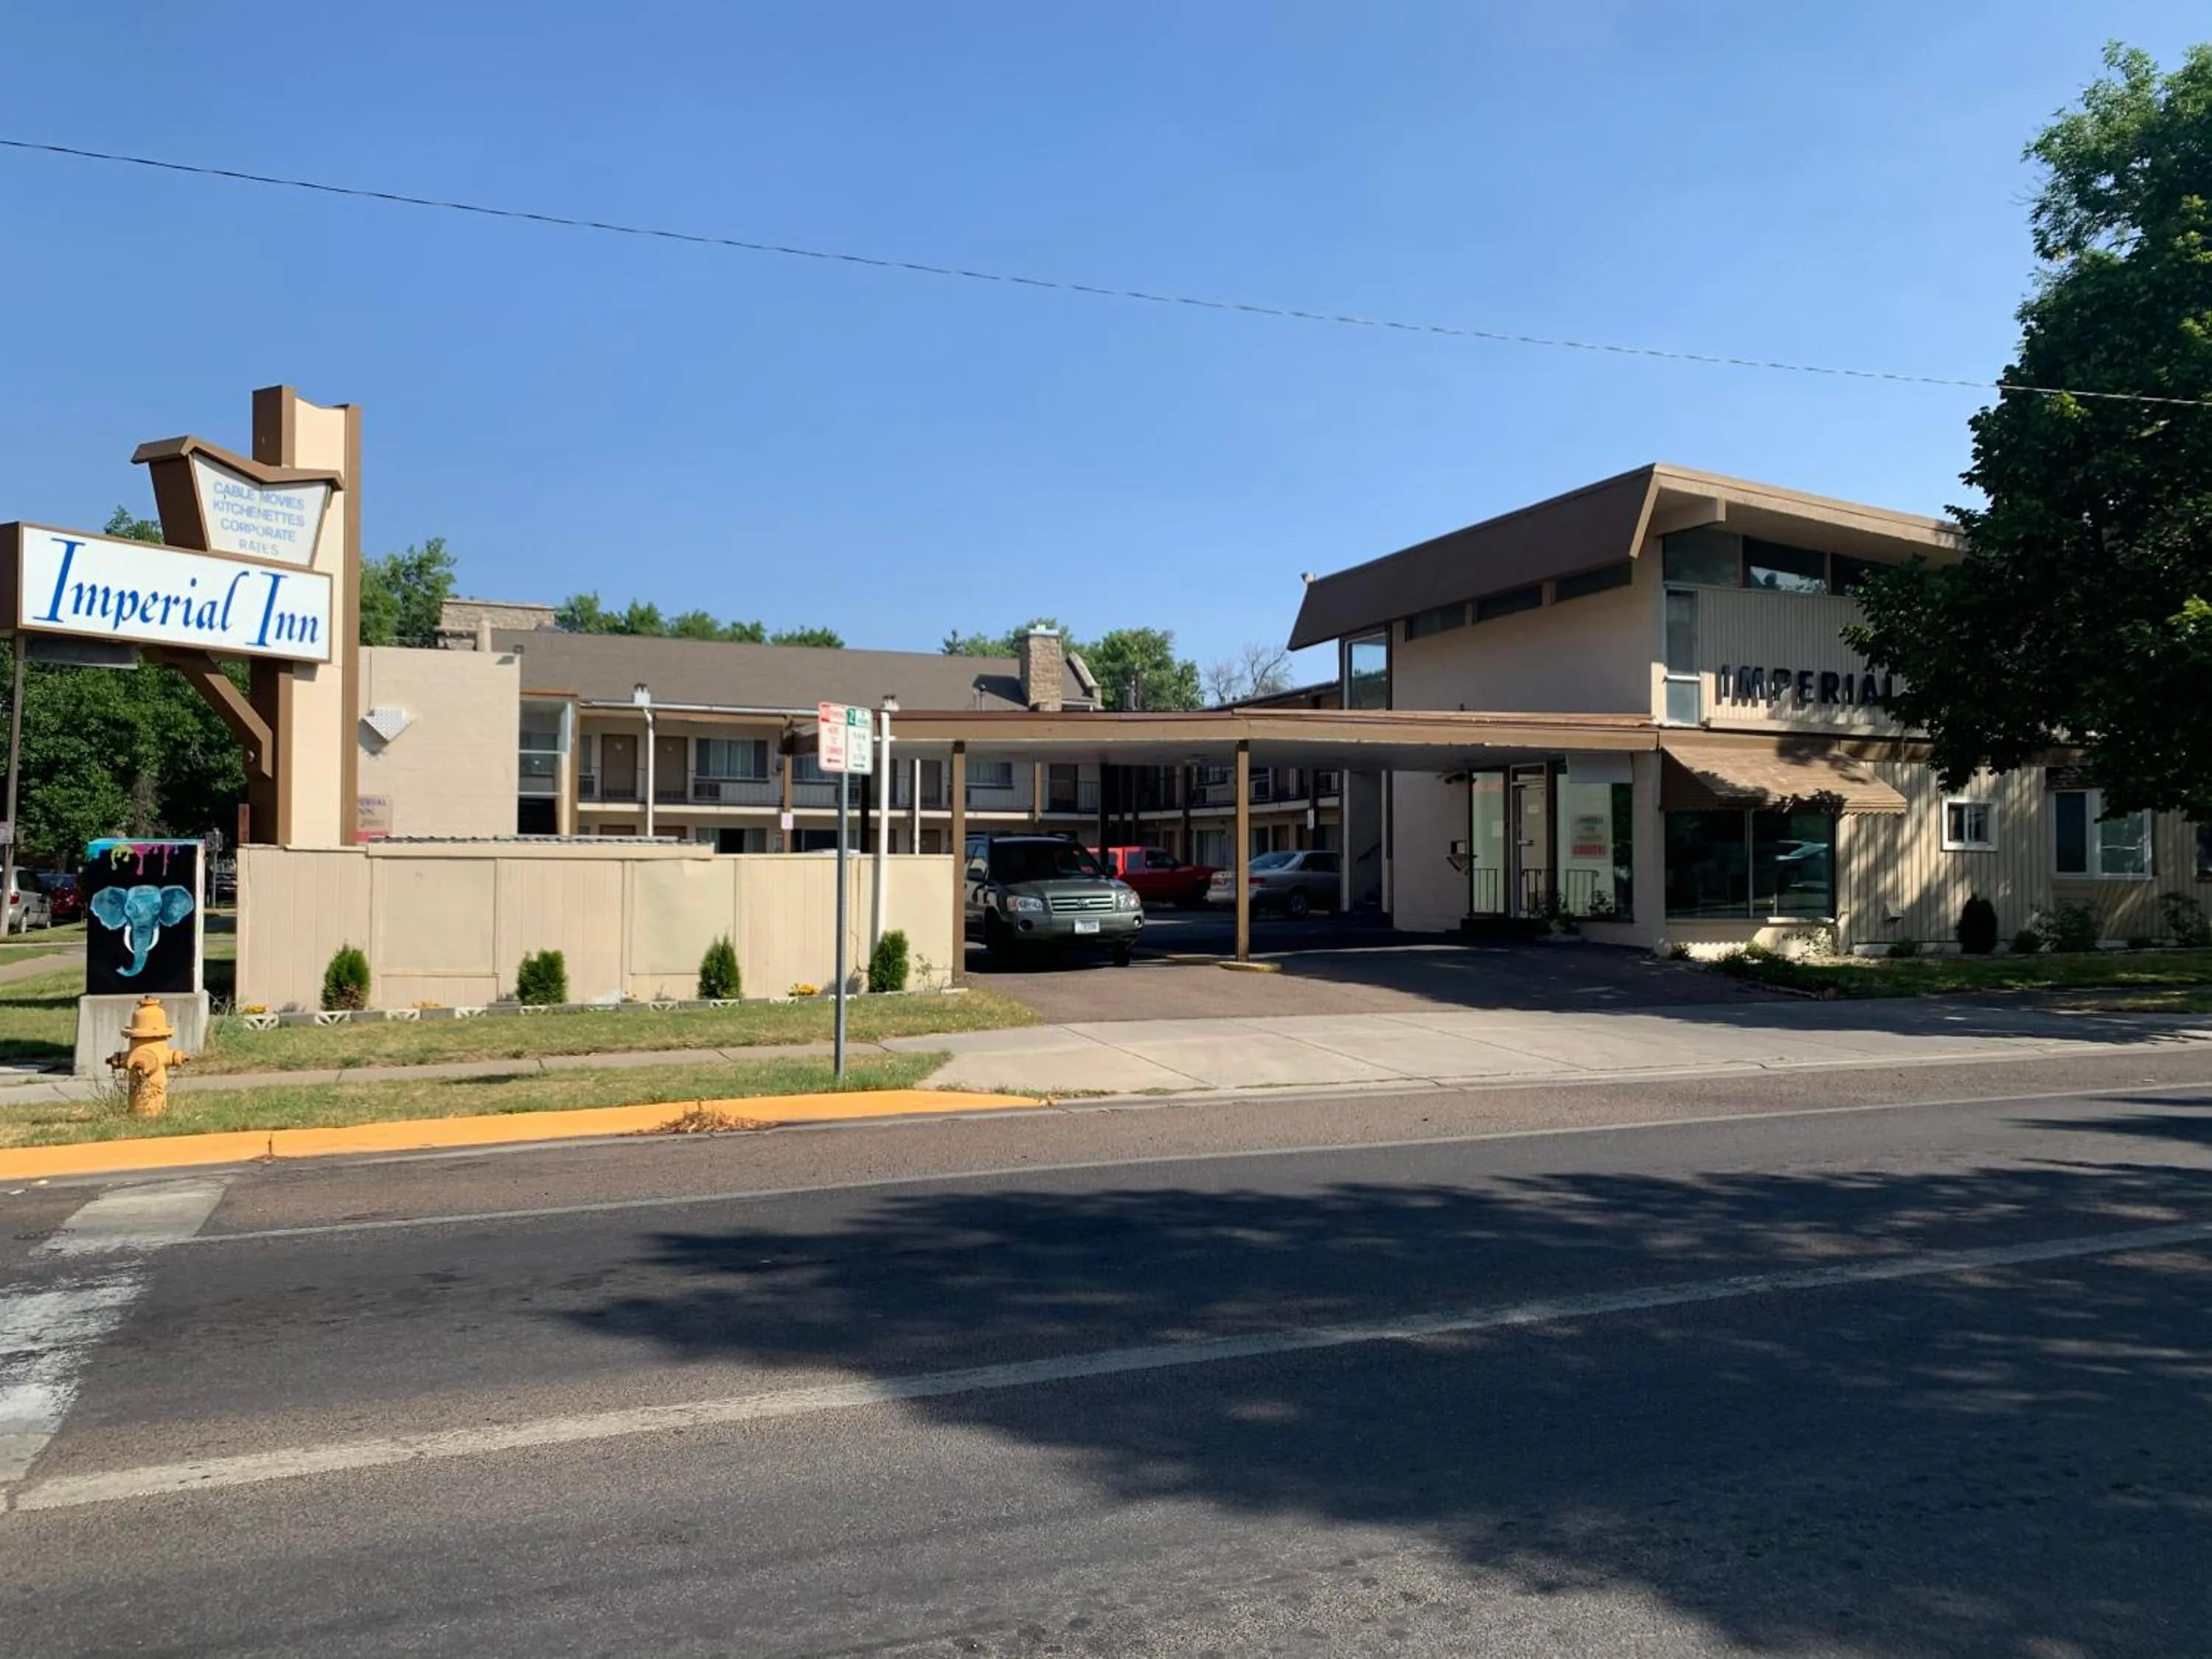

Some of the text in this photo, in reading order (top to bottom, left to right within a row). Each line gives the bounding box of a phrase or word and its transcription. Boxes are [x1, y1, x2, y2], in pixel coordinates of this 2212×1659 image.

[213, 481, 305, 509] CABLE MOVIES
[213, 498, 305, 528] KITCHENETTES
[220, 518, 296, 543] CORPORATE
[239, 539, 279, 556] RATES
[32, 538, 320, 647] Imperial Inn
